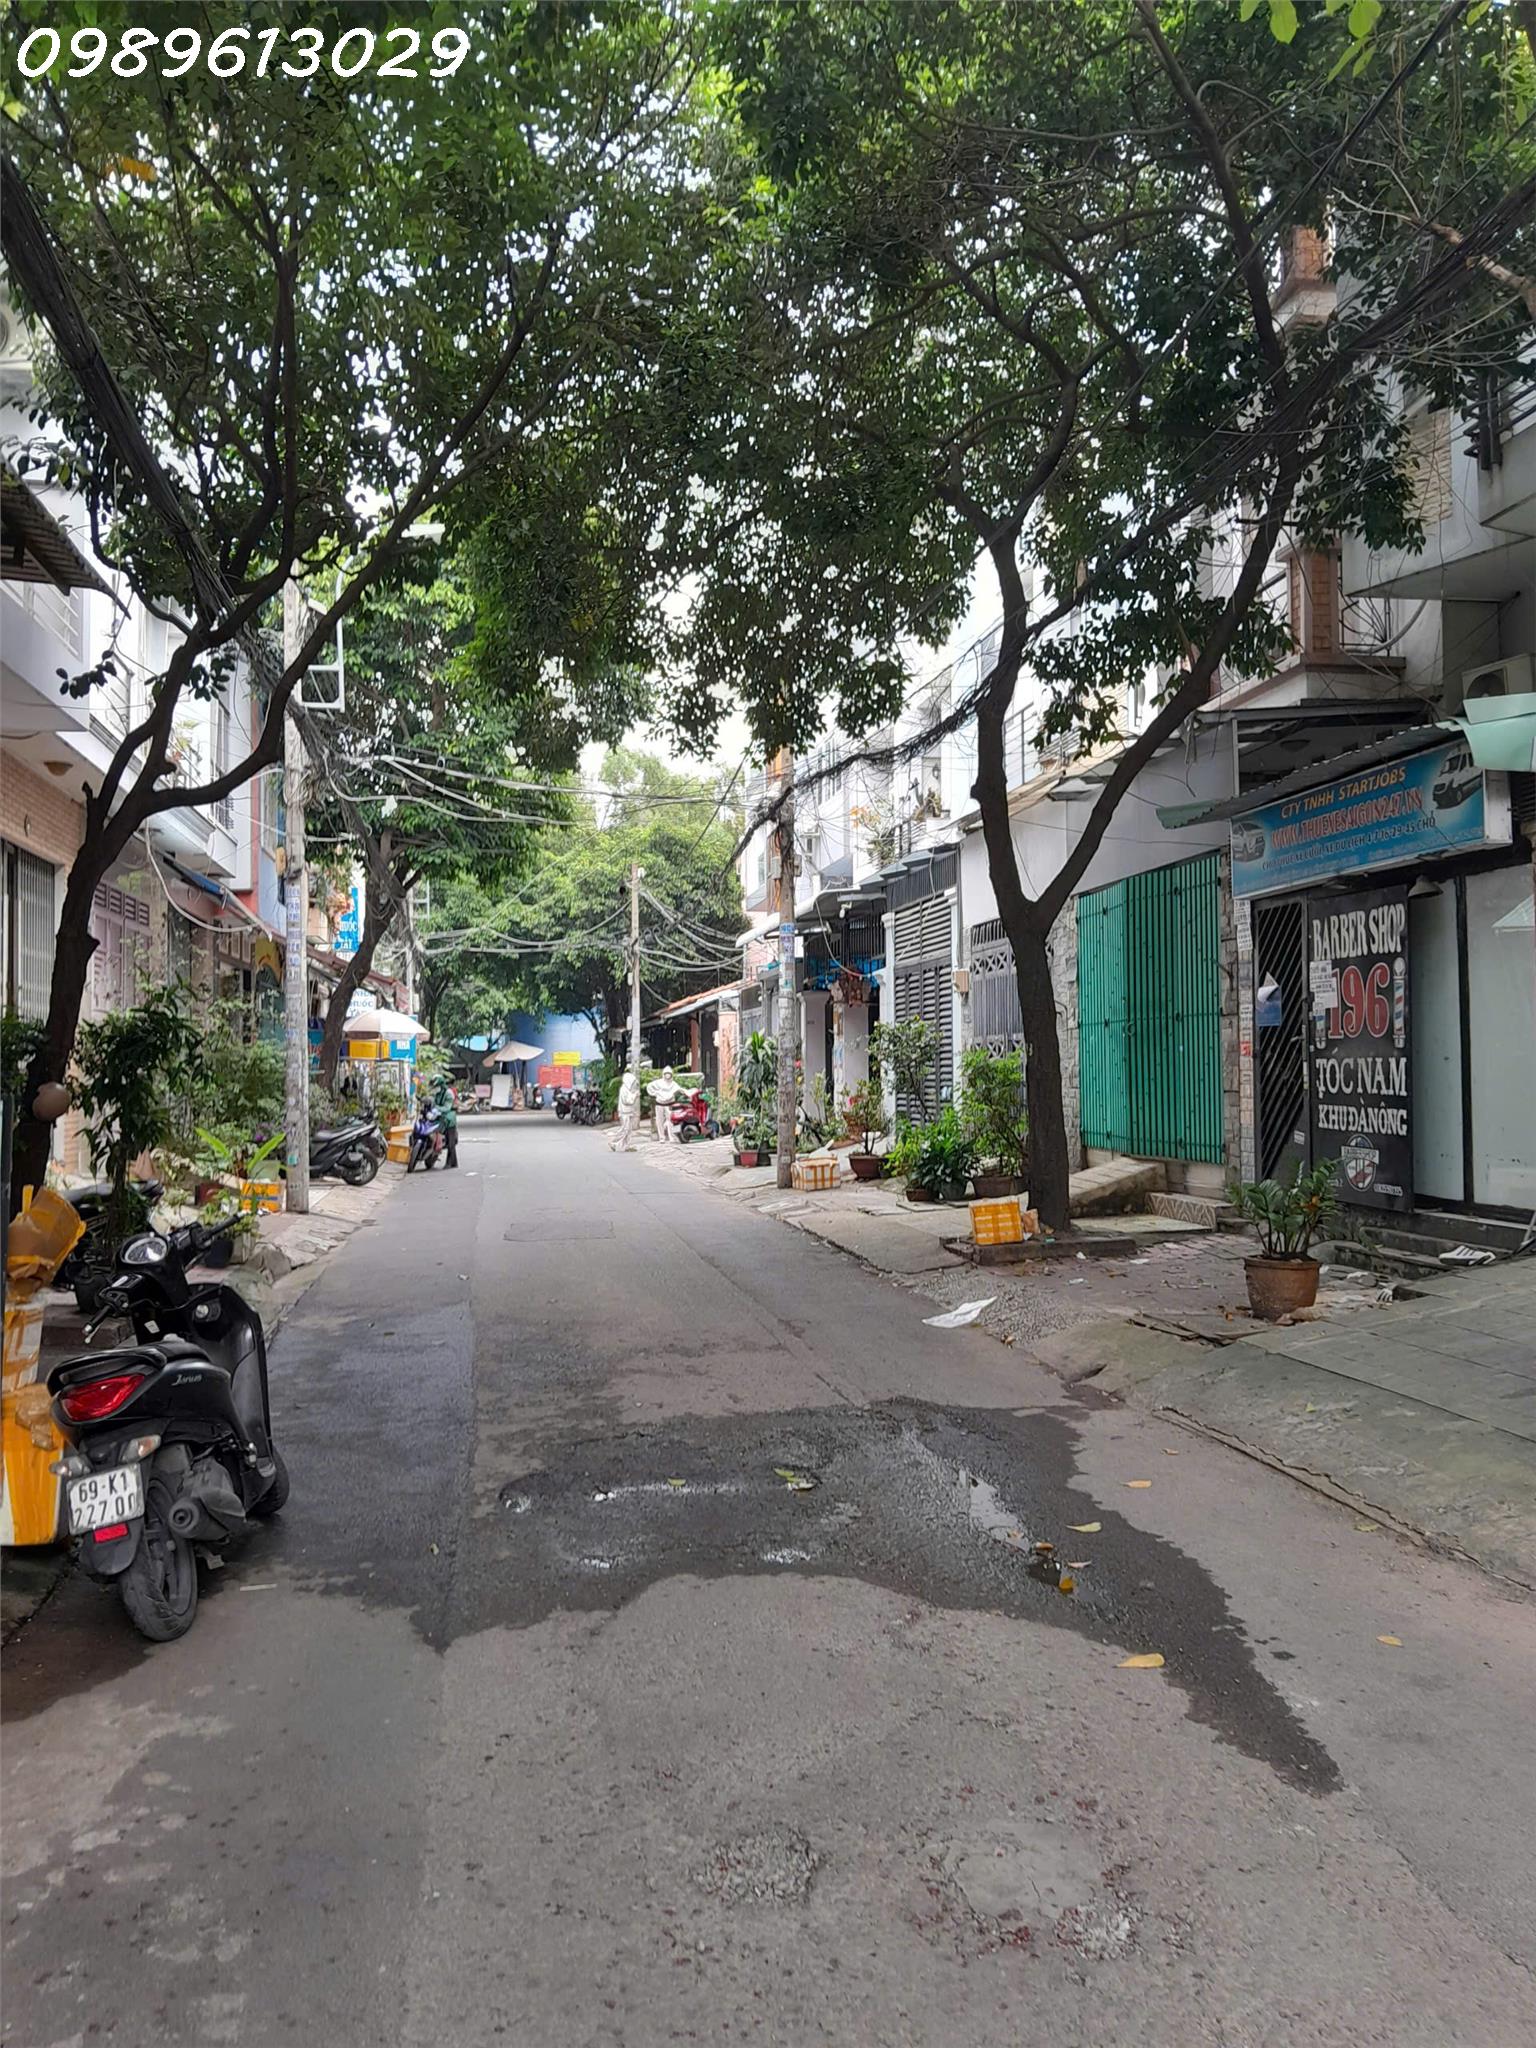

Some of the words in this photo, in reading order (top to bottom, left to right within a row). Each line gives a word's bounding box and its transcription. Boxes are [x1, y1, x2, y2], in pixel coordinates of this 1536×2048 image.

[1281, 800, 1301, 818] CTY
[1304, 790, 1334, 811] TNHH
[1338, 767, 1406, 800] STARTJOBS
[1312, 910, 1368, 961] BARBER
[1369, 903, 1406, 954] SHOP
[1328, 962, 1391, 1039] 196
[1316, 1047, 1354, 1099] TÓC
[1357, 1057, 1407, 1096] NAM
[78, 1471, 128, 1503] 69-K1
